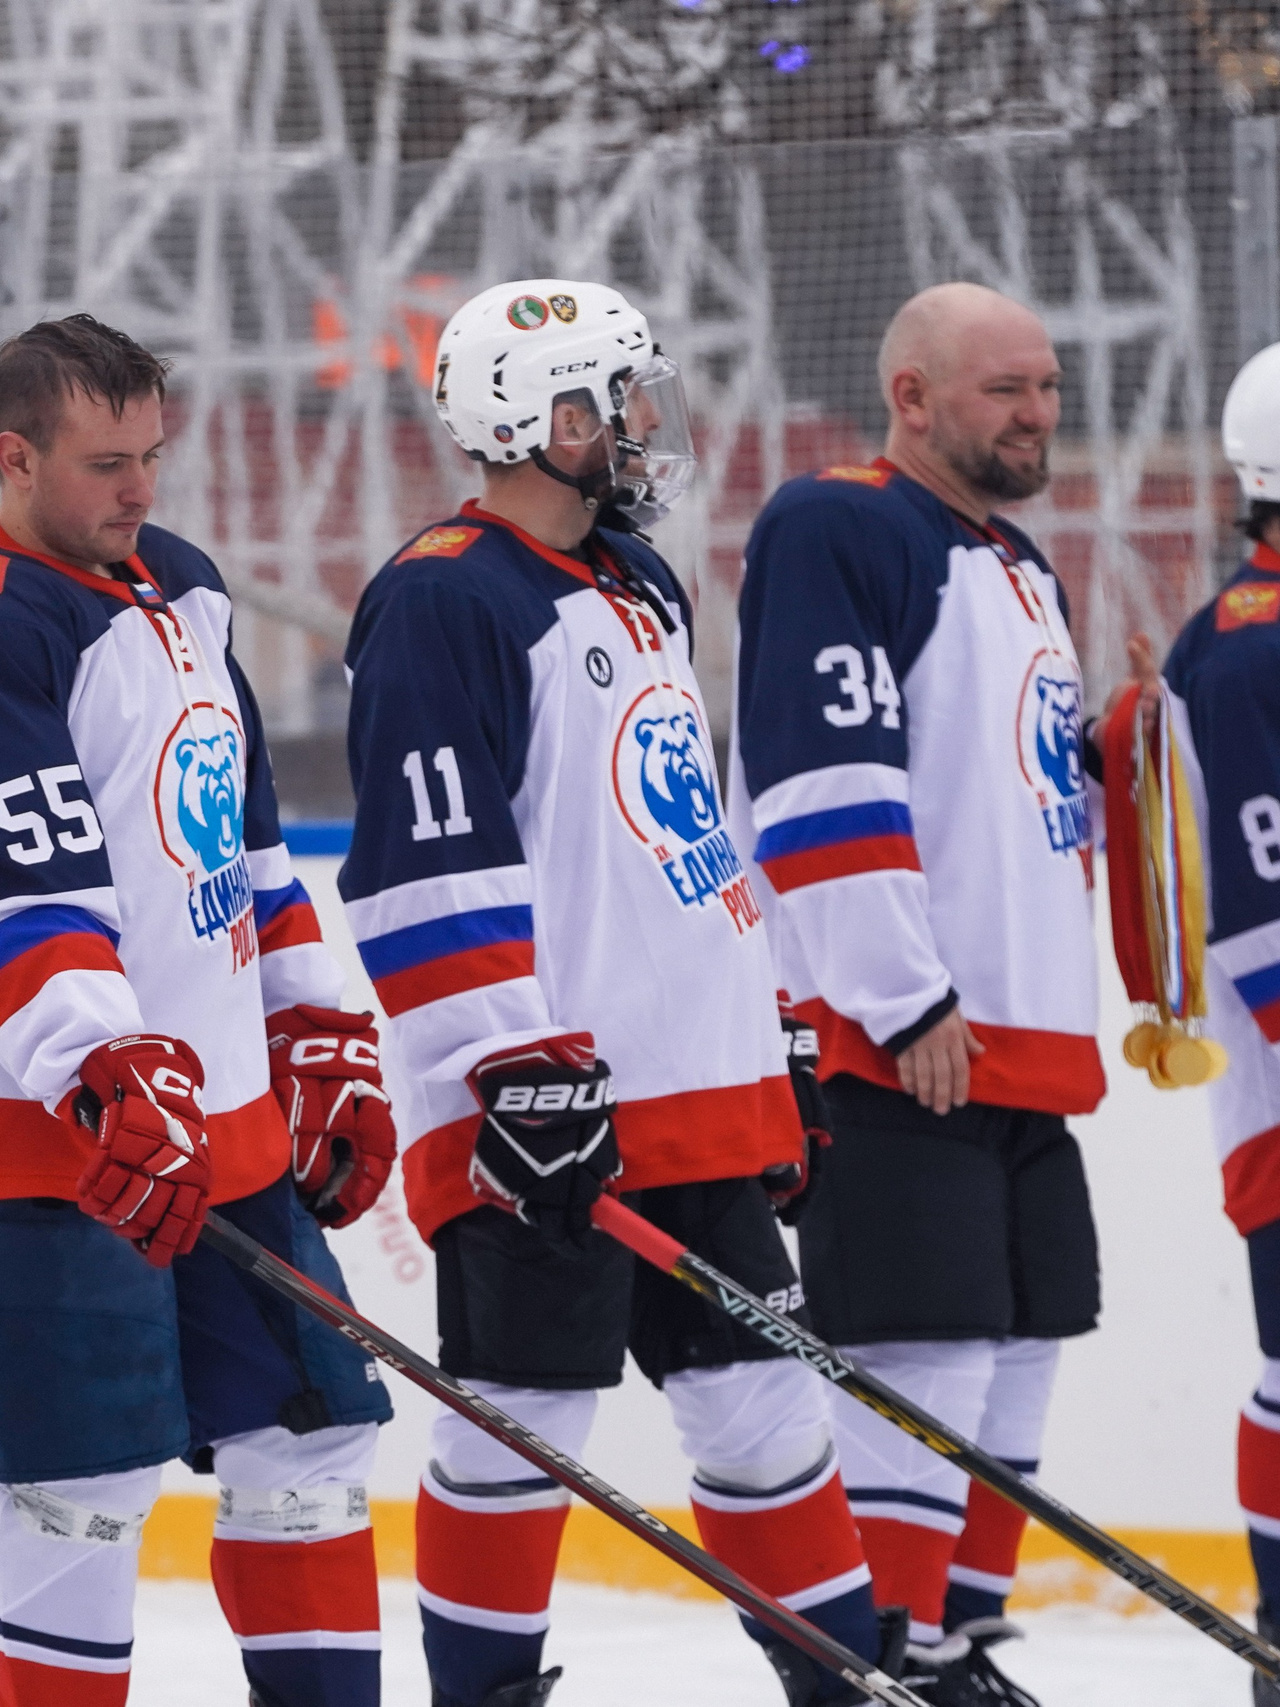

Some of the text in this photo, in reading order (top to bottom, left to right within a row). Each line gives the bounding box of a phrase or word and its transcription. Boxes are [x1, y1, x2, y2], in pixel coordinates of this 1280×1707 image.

[549, 359, 599, 376] CCM
[814, 644, 902, 730] 34
[402, 746, 473, 841] 11
[338, 1324, 407, 1370] CCM
[717, 1283, 850, 1382] VITOKIN
[435, 1377, 669, 1534] JETSPEED
